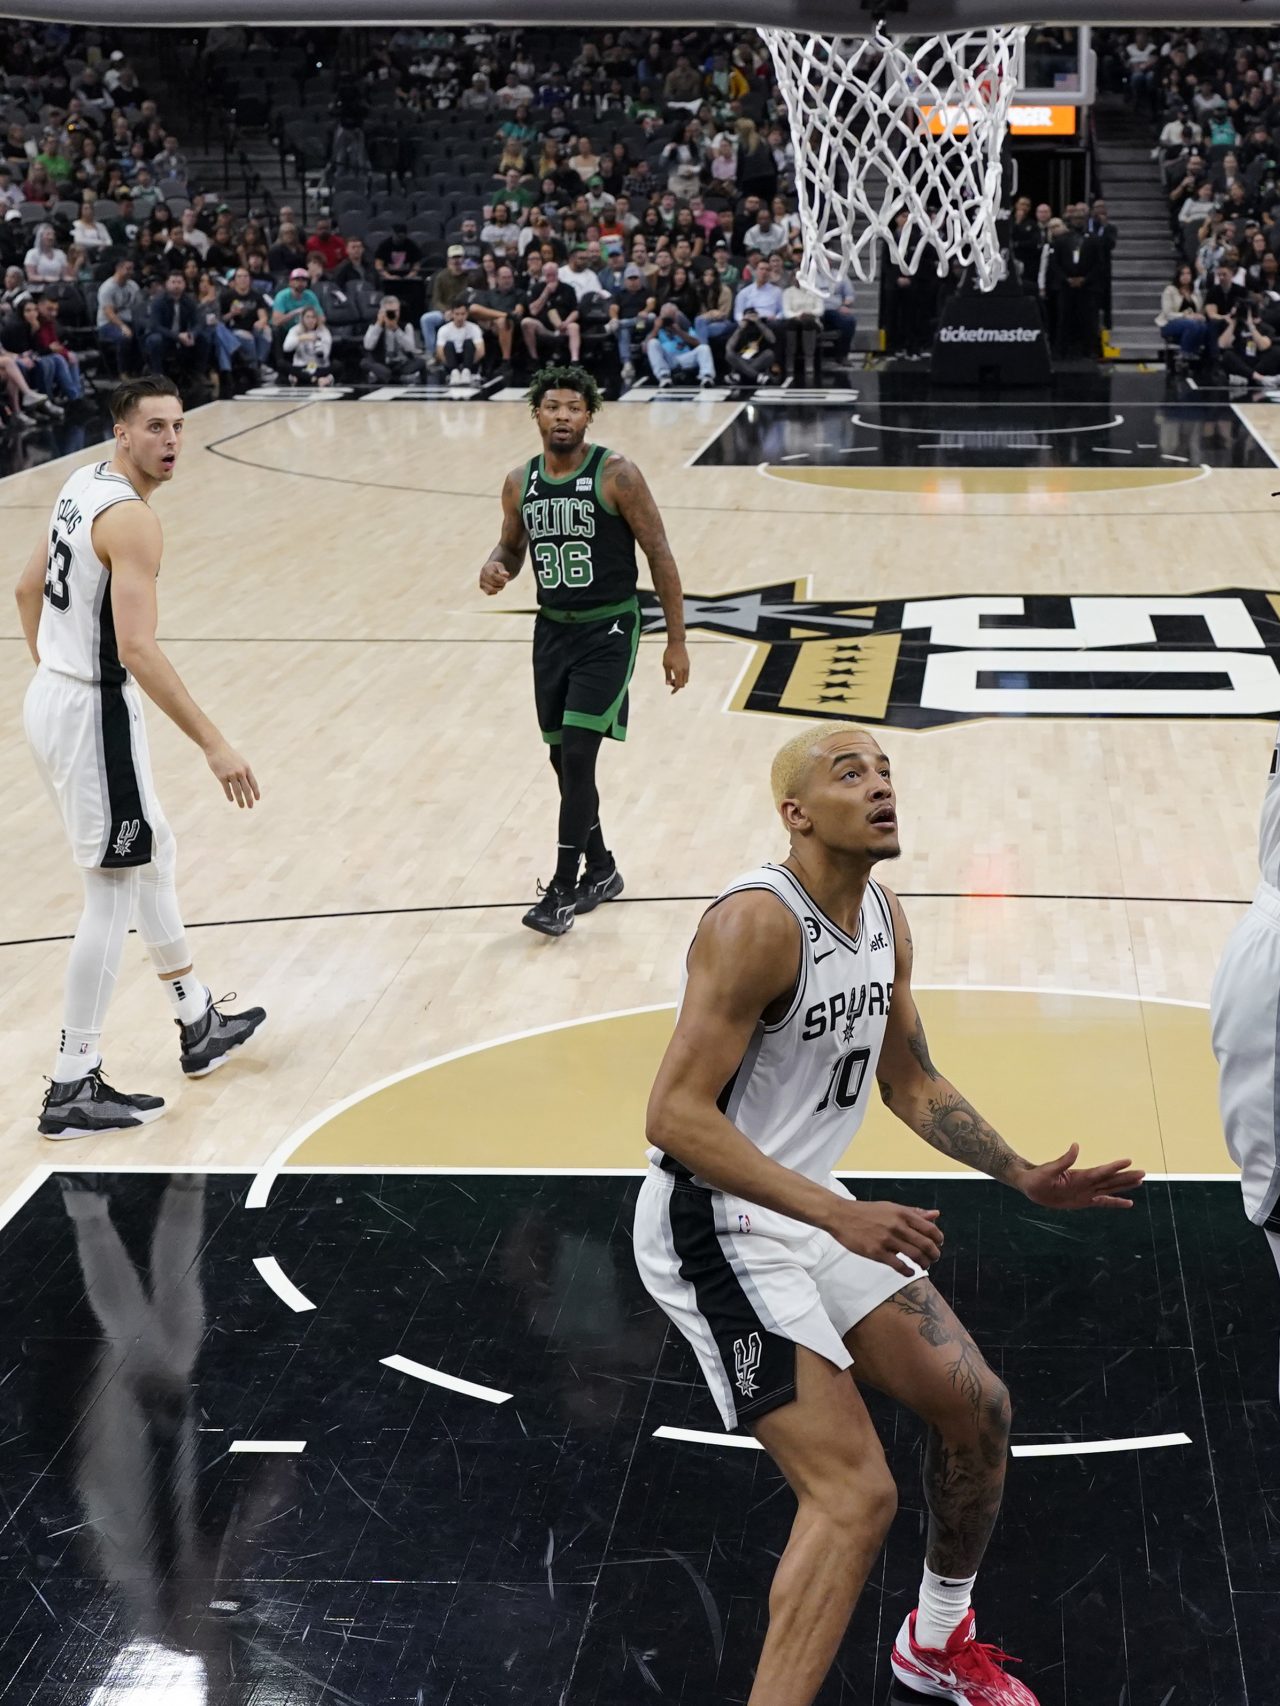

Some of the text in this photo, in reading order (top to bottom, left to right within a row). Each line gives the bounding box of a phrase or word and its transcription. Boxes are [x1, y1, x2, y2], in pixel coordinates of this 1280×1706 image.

[940, 325, 1041, 342] ticketmaster
[523, 497, 595, 540] CELTICS
[534, 541, 594, 588] 36
[811, 1046, 872, 1117] 10
